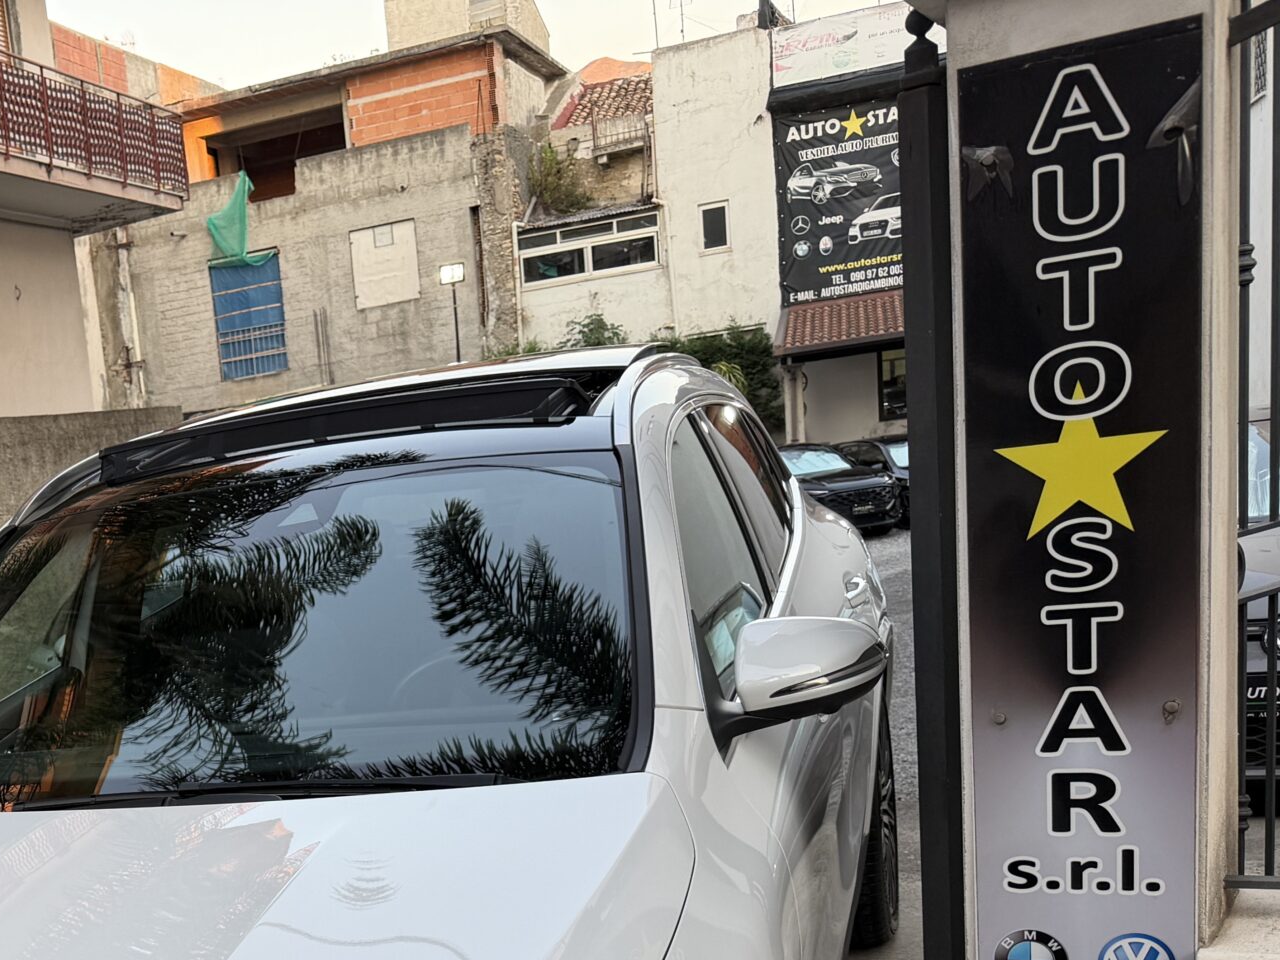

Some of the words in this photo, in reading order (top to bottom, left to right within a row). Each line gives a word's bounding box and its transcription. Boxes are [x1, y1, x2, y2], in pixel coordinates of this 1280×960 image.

[786, 118, 840, 142] AUTO
[867, 106, 899, 127] STA
[798, 145, 836, 161] VENDITA
[838, 139, 862, 154] AUTO
[864, 132, 899, 149] PLURIM
[818, 215, 844, 226] Jeep
[1026, 62, 1132, 422] AUTO
[818, 253, 902, 274] www.autostarsr
[831, 274, 848, 285] TEL.
[850, 271, 865, 283] 090
[866, 269, 877, 280] 97
[878, 266, 888, 277] 62
[789, 290, 818, 302] E-MAIL:
[821, 274, 903, 298] AUTOSTARDIGAMBINO@
[1035, 516, 1131, 838] STAR
[1003, 845, 1165, 896] s.r.l.
[1001, 930, 1061, 951] BMW
